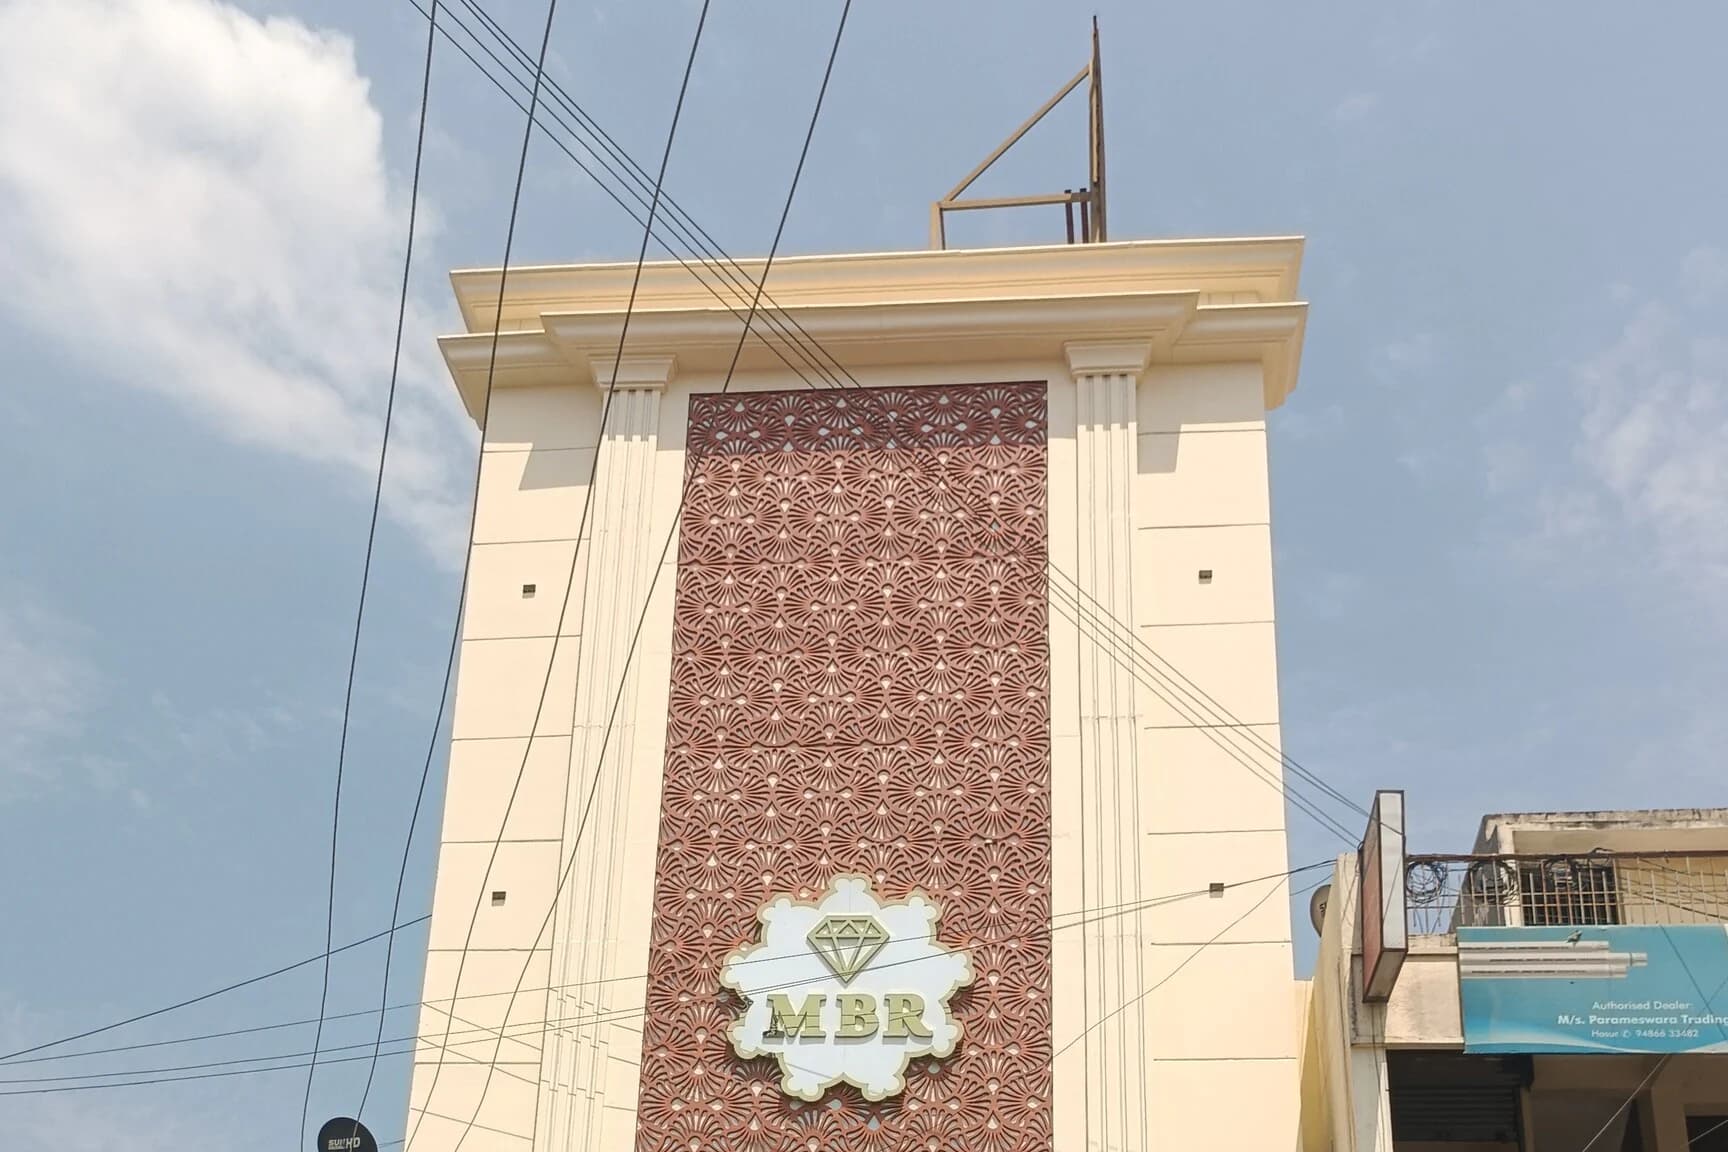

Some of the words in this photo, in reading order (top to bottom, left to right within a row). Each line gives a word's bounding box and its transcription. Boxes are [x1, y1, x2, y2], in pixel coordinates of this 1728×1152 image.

[1592, 1001, 1650, 1010] Authorised
[762, 993, 933, 1038] MBR
[1558, 1015, 1585, 1025] M/s.
[1588, 1015, 1678, 1025] Parameswara
